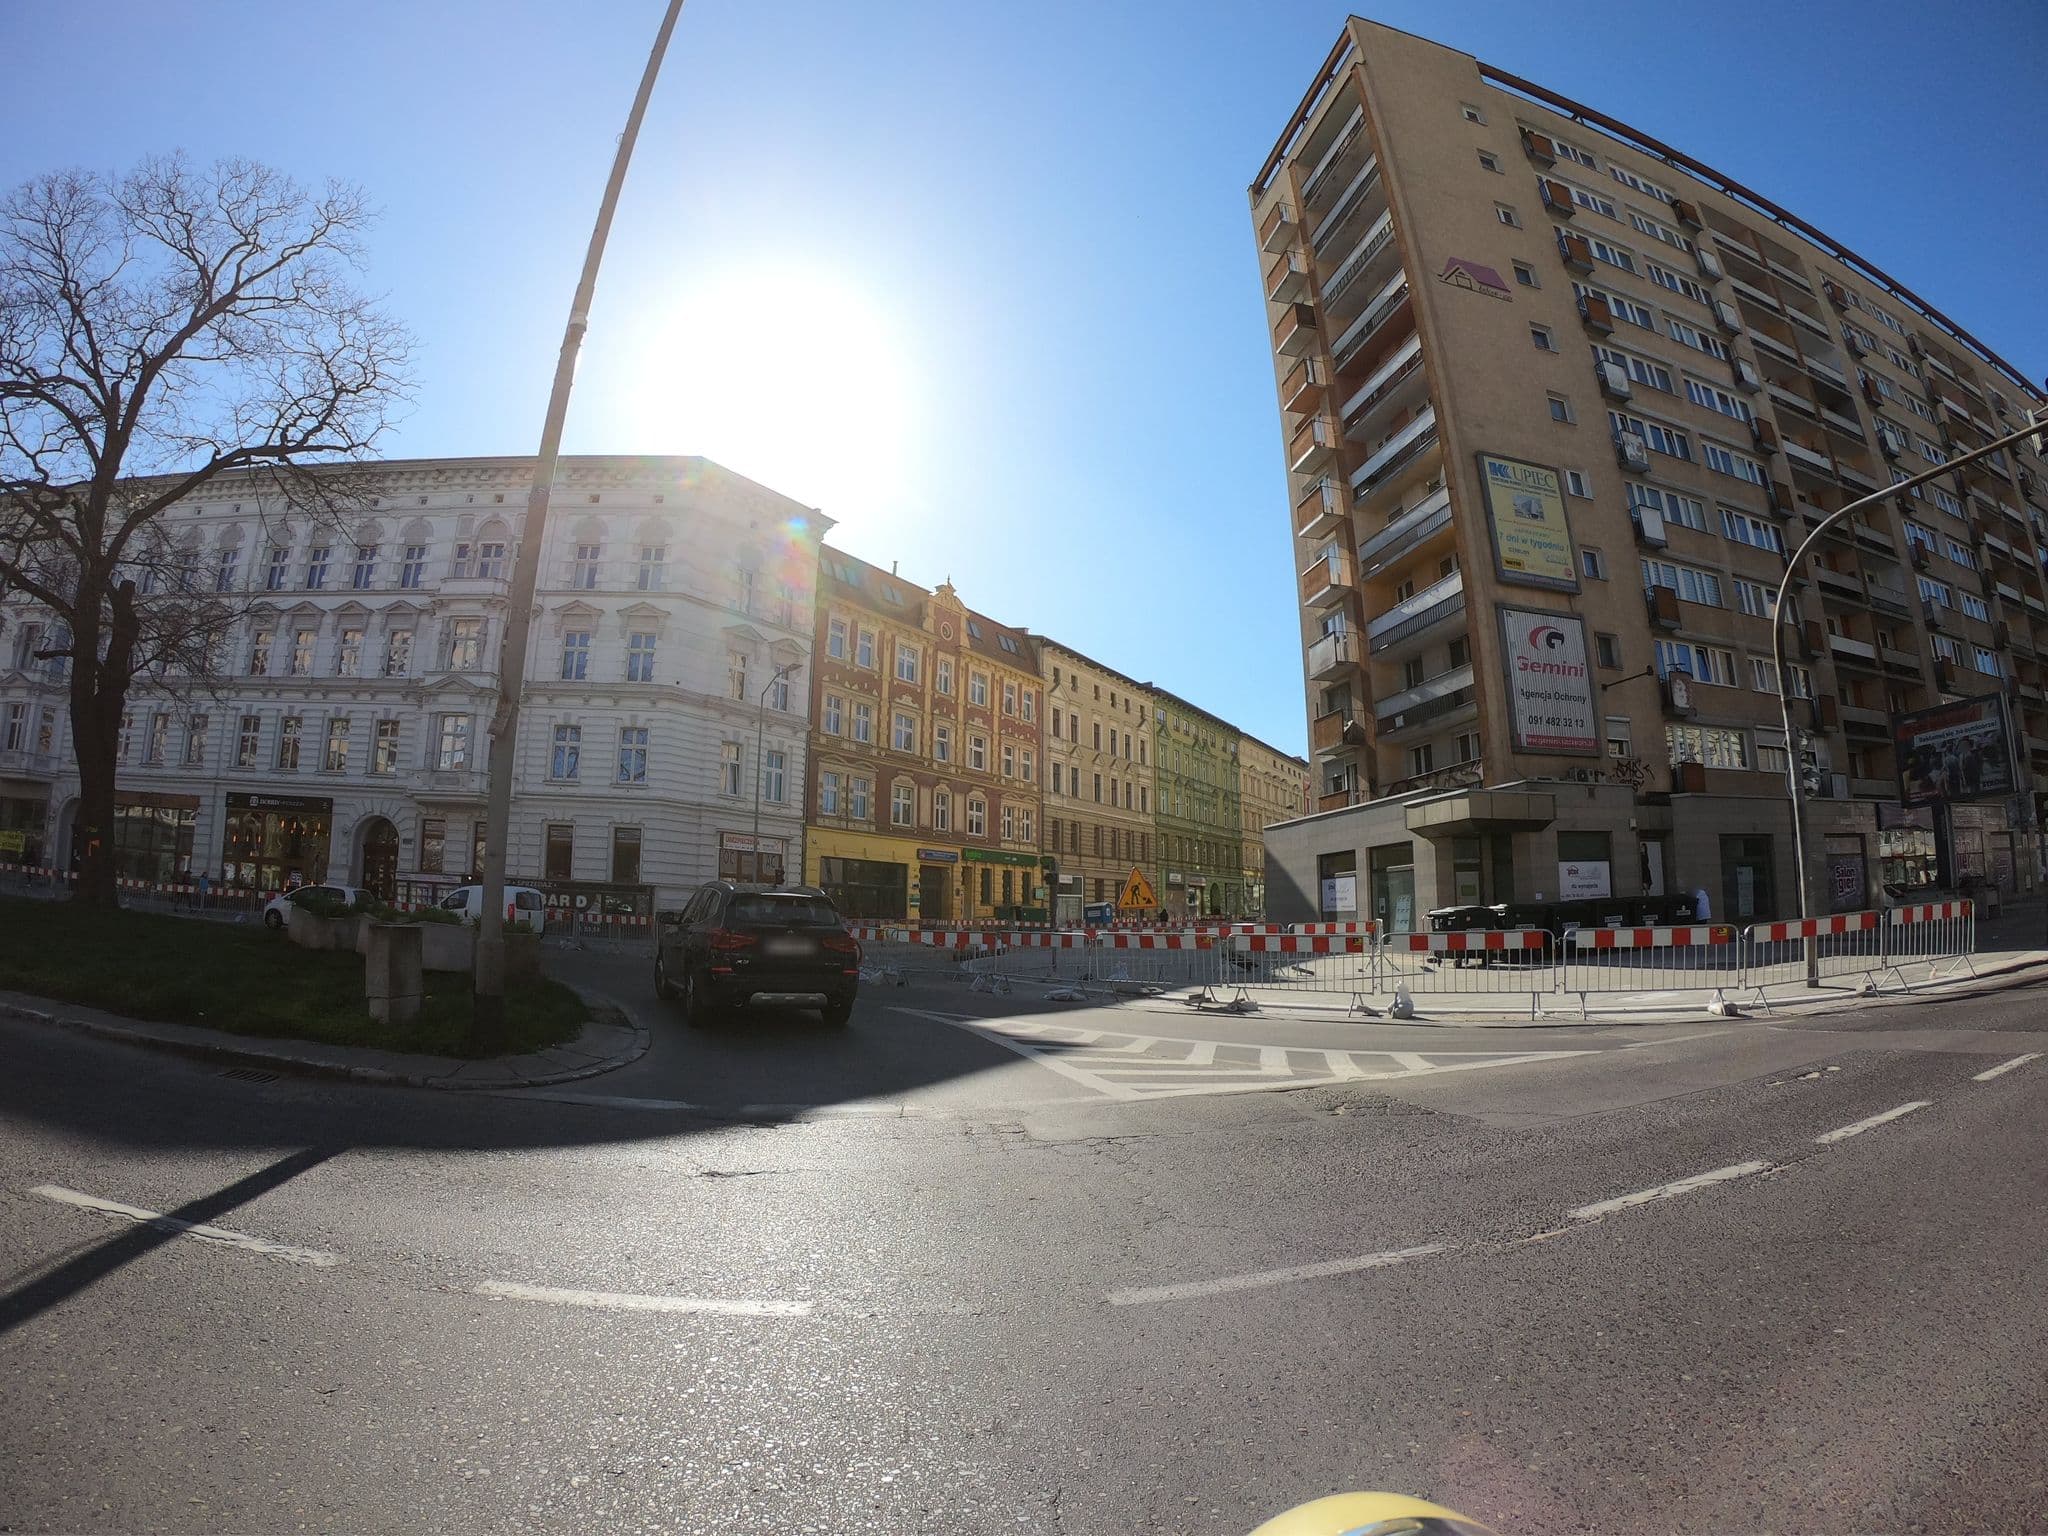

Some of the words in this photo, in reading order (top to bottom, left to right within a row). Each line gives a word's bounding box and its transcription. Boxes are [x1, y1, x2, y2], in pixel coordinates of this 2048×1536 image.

[1517, 655, 1585, 678] Gemini
[1520, 688, 1552, 702] Agencja
[1554, 691, 1587, 705] Ochrony
[1528, 715, 1542, 726] 091
